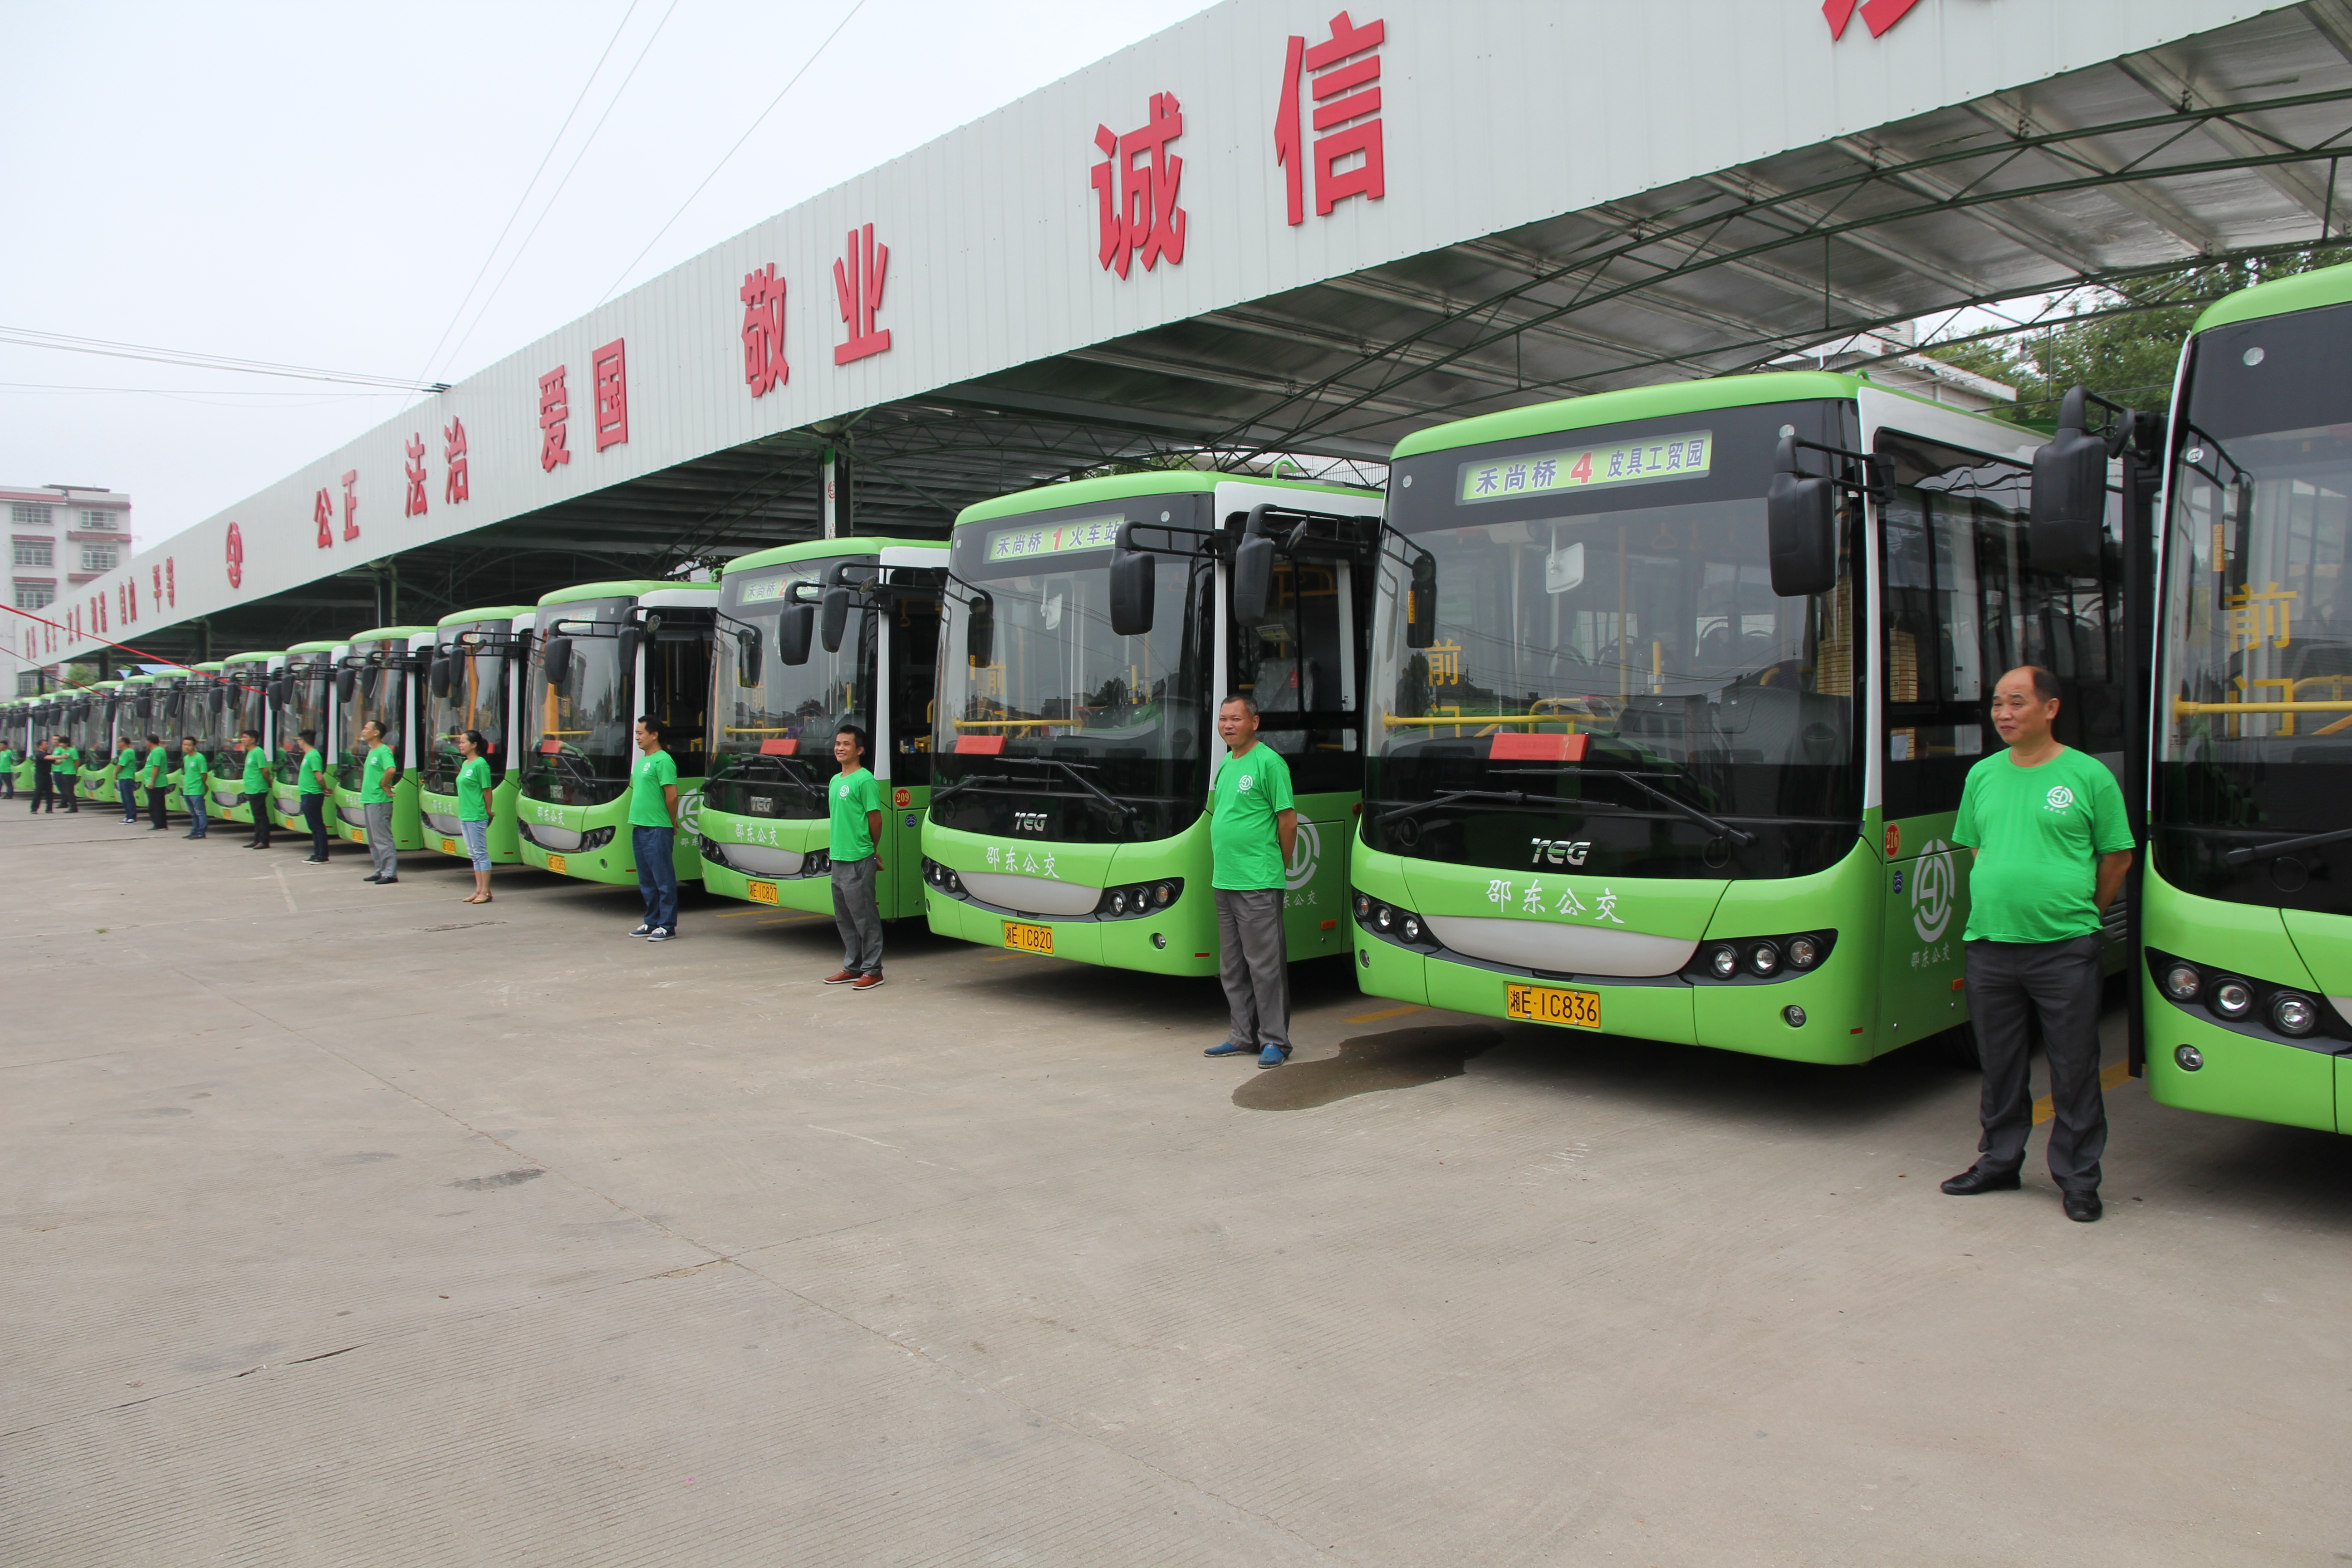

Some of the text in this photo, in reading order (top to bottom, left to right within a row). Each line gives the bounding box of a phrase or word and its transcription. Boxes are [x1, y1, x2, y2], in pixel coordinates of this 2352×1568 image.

[152, 556, 174, 612] 平等
[314, 469, 360, 549] 公正
[405, 415, 469, 518] 法治
[539, 337, 628, 473] 爱国
[740, 222, 892, 398] 敬业
[1090, 10, 1385, 281] 诚信
[1474, 438, 1705, 495] 禾尚桥 4 皮具工贸园
[996, 519, 1122, 557] 禾尚桥 1 火车站
[778, 578, 789, 597] 2
[2225, 581, 2298, 737] 前门
[1425, 638, 1462, 739] 前门
[896, 792, 910, 803] 209
[735, 823, 780, 847] 邵东公交
[1014, 812, 1048, 832] TEG
[1531, 838, 1592, 866] TEG
[1886, 831, 1898, 849] 216
[985, 846, 1060, 879] 邵东公交
[1485, 878, 1625, 924] 邵东公交
